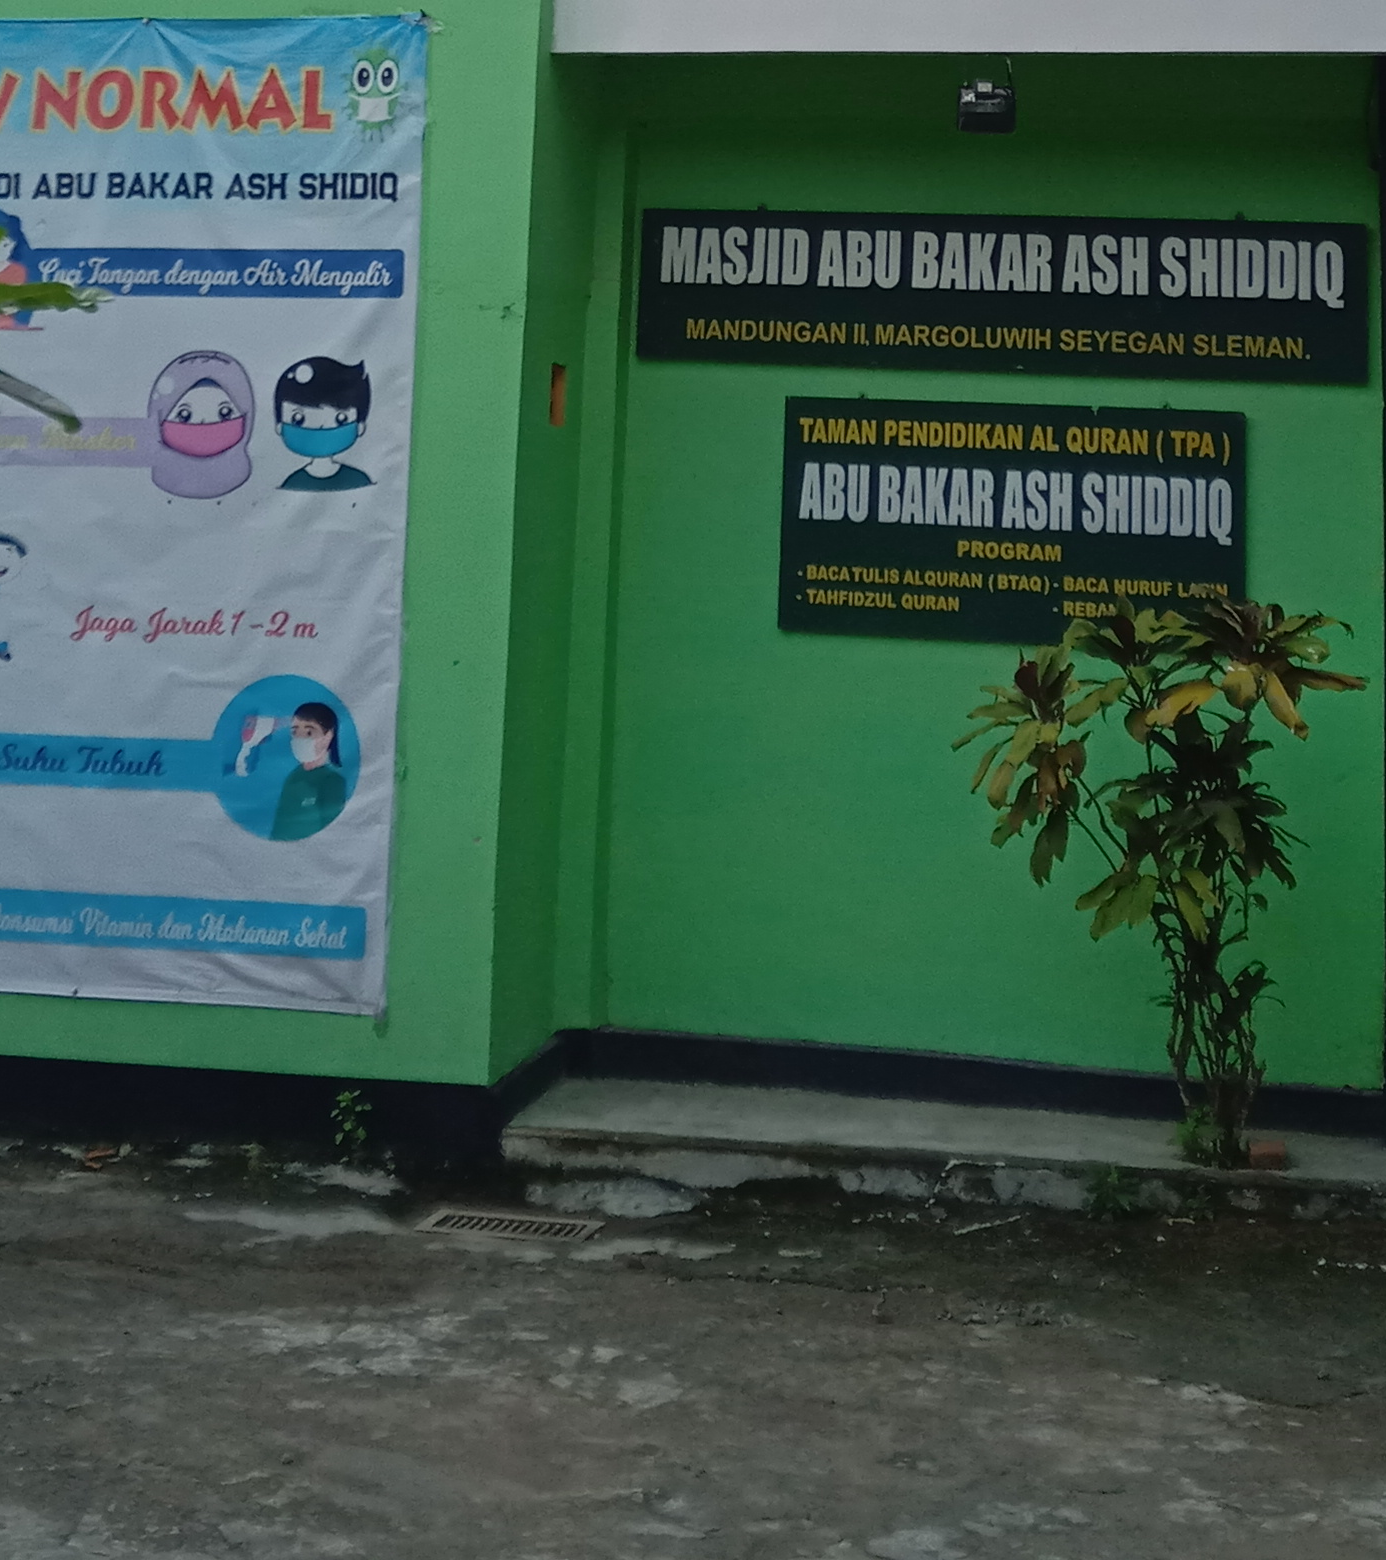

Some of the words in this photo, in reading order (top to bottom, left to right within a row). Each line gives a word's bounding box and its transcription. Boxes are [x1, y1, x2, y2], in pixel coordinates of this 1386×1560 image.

[31, 66, 333, 132] NORMAL
[32, 172, 99, 200] ABU
[105, 172, 214, 200] BAKAR
[225, 172, 289, 200] ASH
[299, 172, 399, 202] SHIDIQ
[87, 257, 161, 294] Tangan
[165, 259, 239, 295] dengan
[238, 259, 288, 287] Air
[290, 259, 393, 296] Mengalir
[660, 226, 810, 285] MASJID
[817, 230, 902, 289] ABU
[912, 231, 1052, 292] BAKAR
[1062, 234, 1149, 296] ASH
[1160, 237, 1344, 309] SHIDDIQ
[686, 318, 846, 344] MANDUNGAN
[875, 324, 1051, 350] MARGOLUWIH
[1059, 329, 1185, 355] SEYEGAN
[1193, 334, 1311, 360] SLEMAN.
[799, 417, 877, 445] TAMAN
[884, 419, 1023, 450] PENDIDIKAN
[1029, 424, 1060, 452] AL
[1066, 426, 1149, 455] QURAN
[798, 462, 870, 523] ABU
[878, 464, 995, 528] BAKAR
[1001, 469, 1073, 531] ASH
[1081, 471, 1232, 546] SHIDDIQ
[956, 540, 1062, 562] PROGRAM
[806, 564, 850, 581] BACA
[851, 567, 900, 585] TULIS
[902, 569, 983, 589] ALQURAN
[1063, 576, 1109, 594] BACA
[1114, 578, 1173, 597] HURUF
[806, 588, 897, 609] TAHFIDZUL
[901, 594, 960, 612] QURAN
[70, 605, 137, 642] Jaga
[143, 608, 225, 643] Jarak
[74, 746, 168, 777] Tubuh
